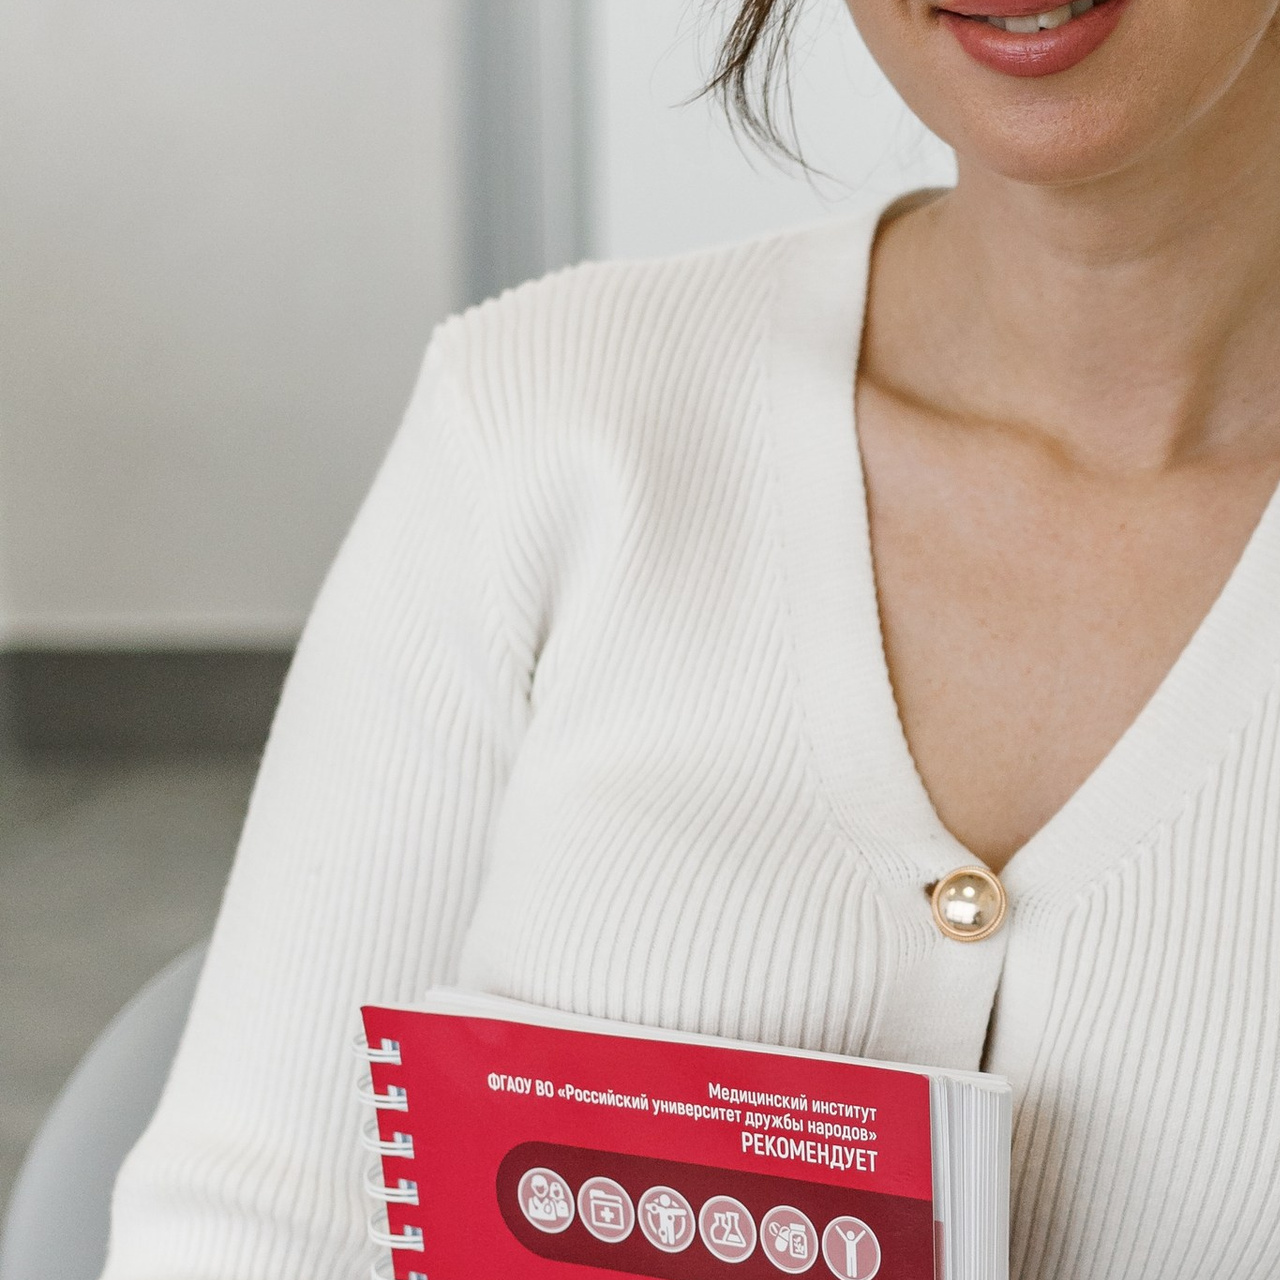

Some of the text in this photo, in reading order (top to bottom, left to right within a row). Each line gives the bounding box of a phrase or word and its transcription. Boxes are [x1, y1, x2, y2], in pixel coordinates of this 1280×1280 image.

[487, 1072, 878, 1141] ФГАОУ ВО «Российский университет дружбы народов»
[708, 1082, 877, 1123] Медицинский институт
[741, 1131, 878, 1172] РЕКОМЕНДУЕТ
